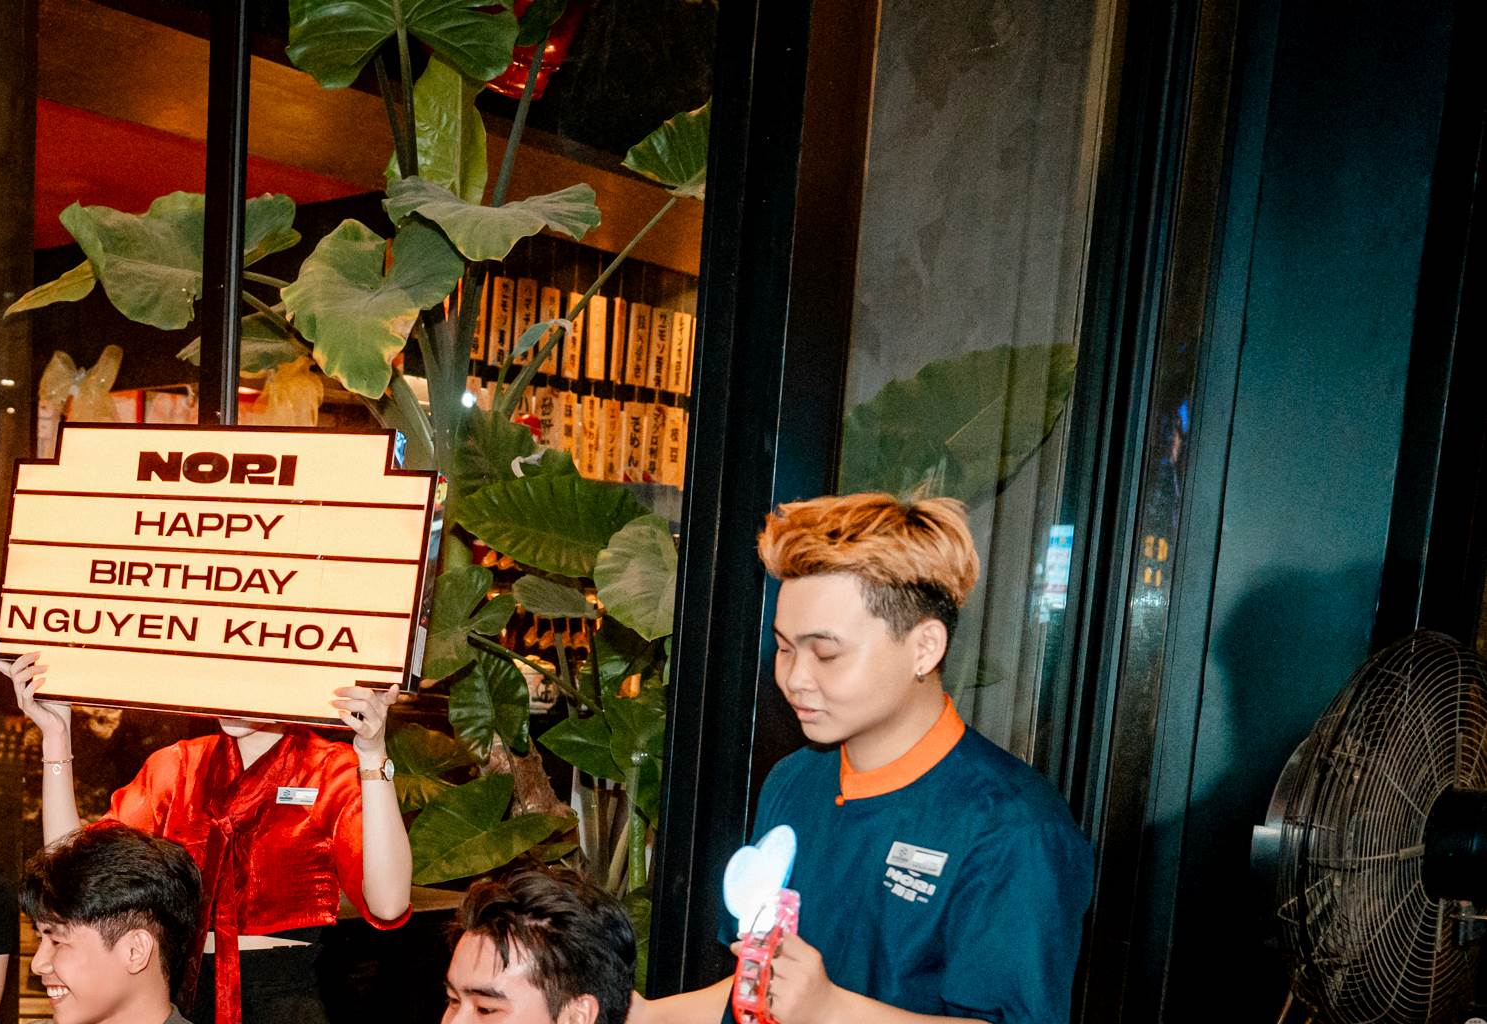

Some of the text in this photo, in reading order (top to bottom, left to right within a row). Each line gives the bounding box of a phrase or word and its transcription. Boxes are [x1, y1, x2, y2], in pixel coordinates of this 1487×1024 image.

[137, 451, 298, 487] NORI
[134, 510, 284, 541] HAPPY
[89, 559, 298, 595] BIRTHDAY
[7, 604, 359, 653] NGUYEN KHOA
[885, 866, 936, 897] NORI
